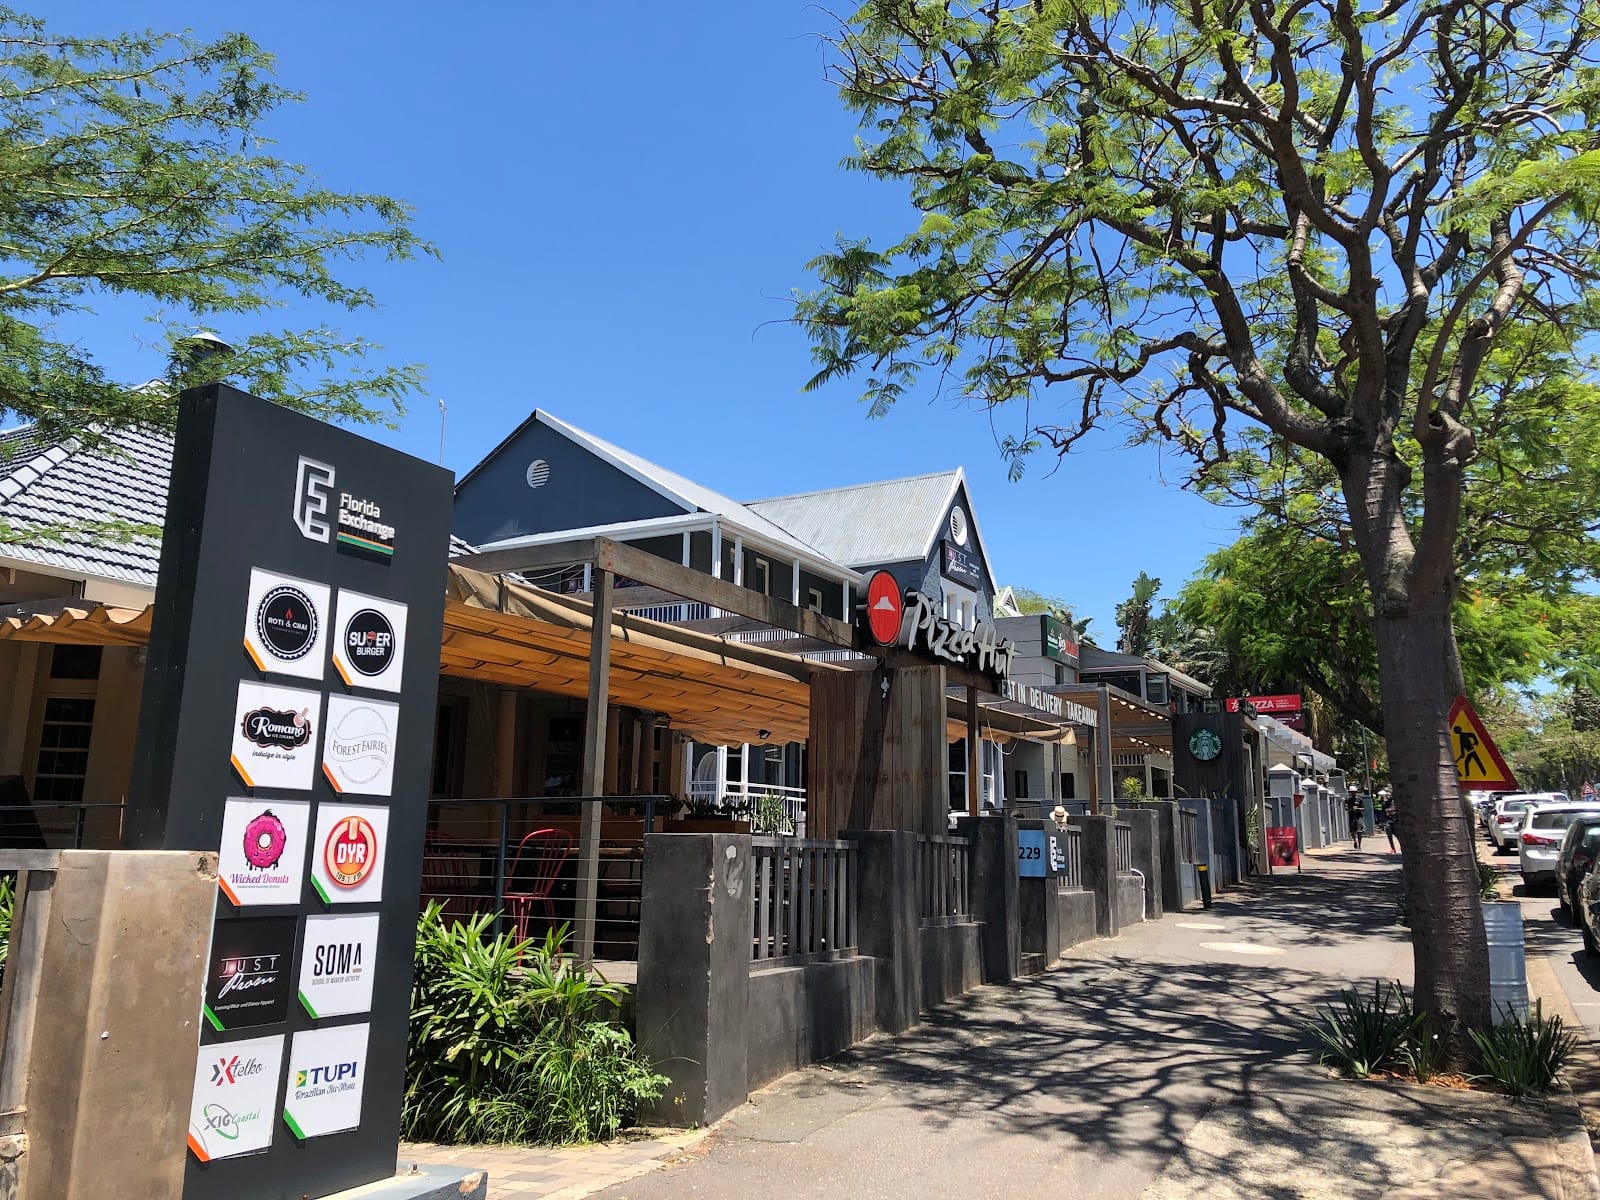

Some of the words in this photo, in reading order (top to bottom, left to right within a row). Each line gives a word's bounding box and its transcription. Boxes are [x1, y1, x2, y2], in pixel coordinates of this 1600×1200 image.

[340, 492, 380, 518] Florida
[338, 508, 395, 540] Exchange
[267, 617, 284, 626] ROTI
[285, 620, 291, 628] &
[900, 588, 977, 663] Pizza
[972, 619, 1023, 680] Hut
[356, 647, 385, 656] BURGER
[1001, 679, 1016, 702] EAT
[1017, 682, 1026, 705] IN
[1030, 687, 1063, 717] DELIVERY
[1066, 700, 1099, 728] TAKEAWAY
[251, 716, 305, 737] Romano
[332, 740, 361, 756] FOREST
[337, 843, 366, 864] DYR
[1018, 846, 1041, 860] 229
[230, 873, 262, 884] Wicked
[222, 957, 278, 974] JUST
[313, 942, 362, 977] SOMA
[309, 1061, 358, 1085] TUPI
